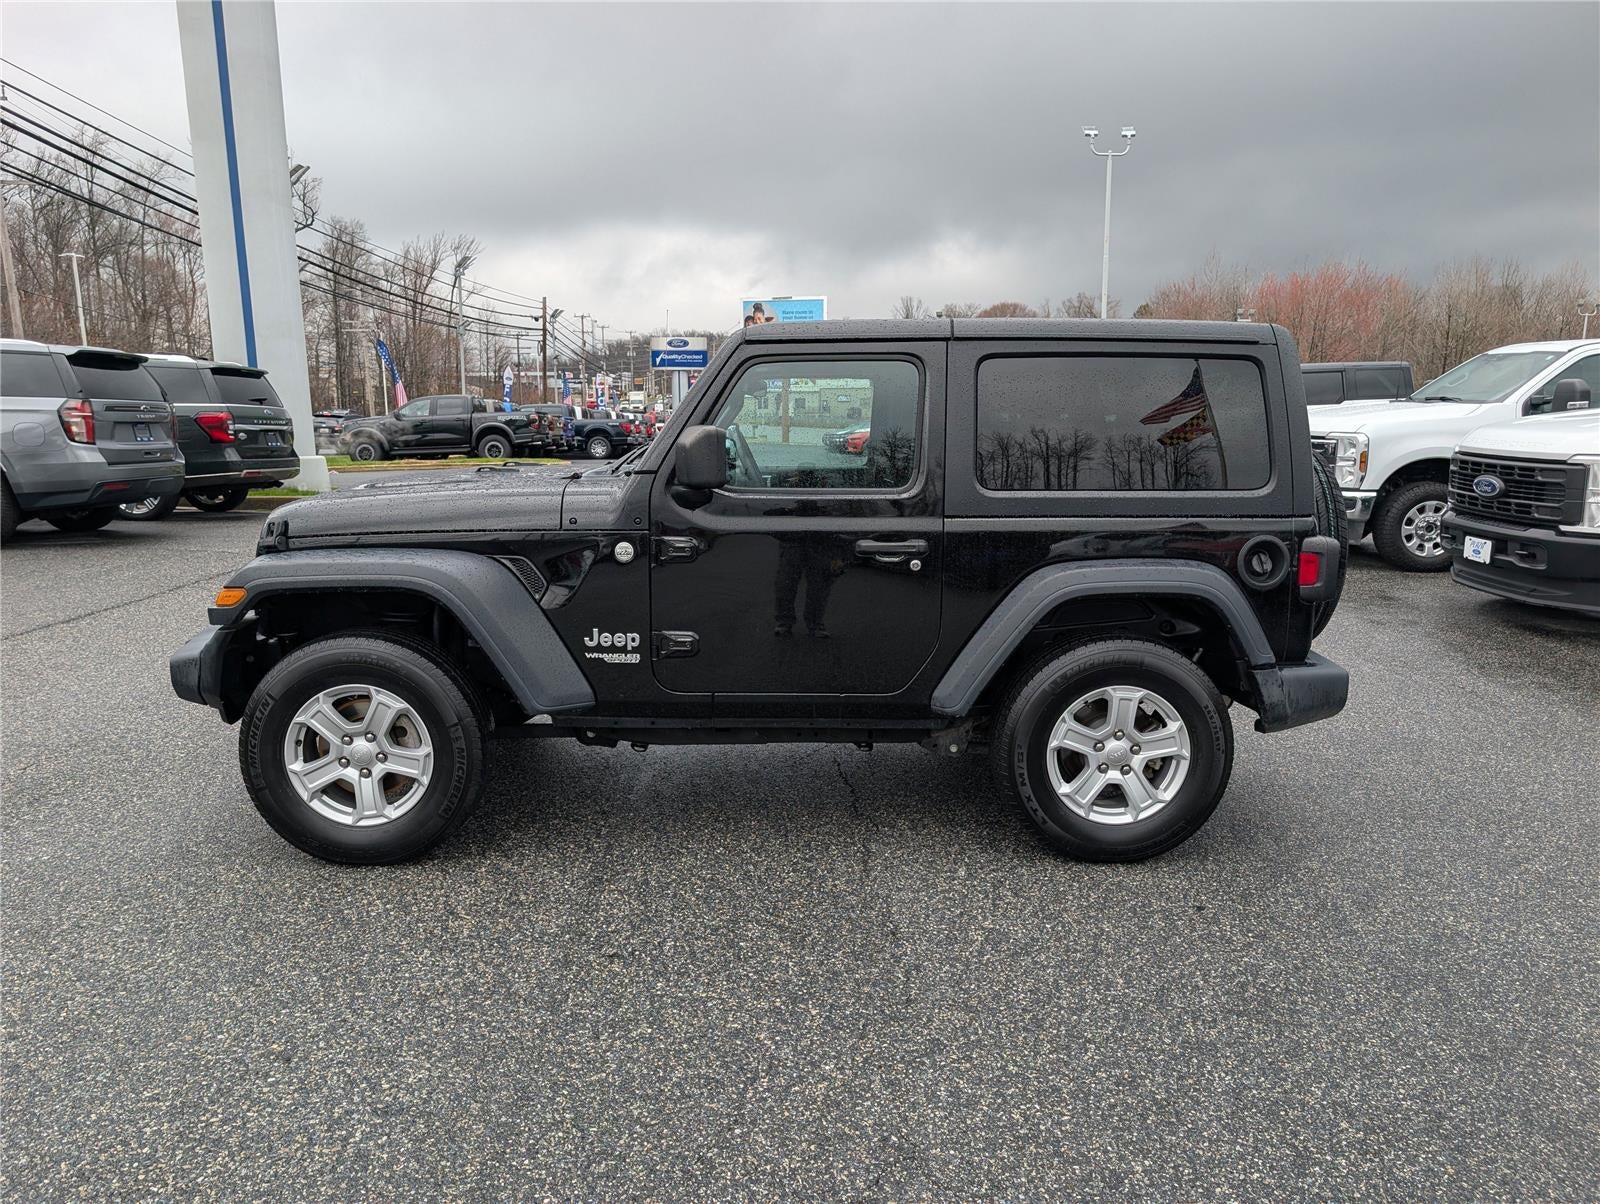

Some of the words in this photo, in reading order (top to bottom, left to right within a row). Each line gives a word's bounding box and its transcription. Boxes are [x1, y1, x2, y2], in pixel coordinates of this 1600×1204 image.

[583, 628, 640, 651] Jeep
[249, 697, 271, 769] MICHELIN
[440, 746, 467, 818] MICHELIN
